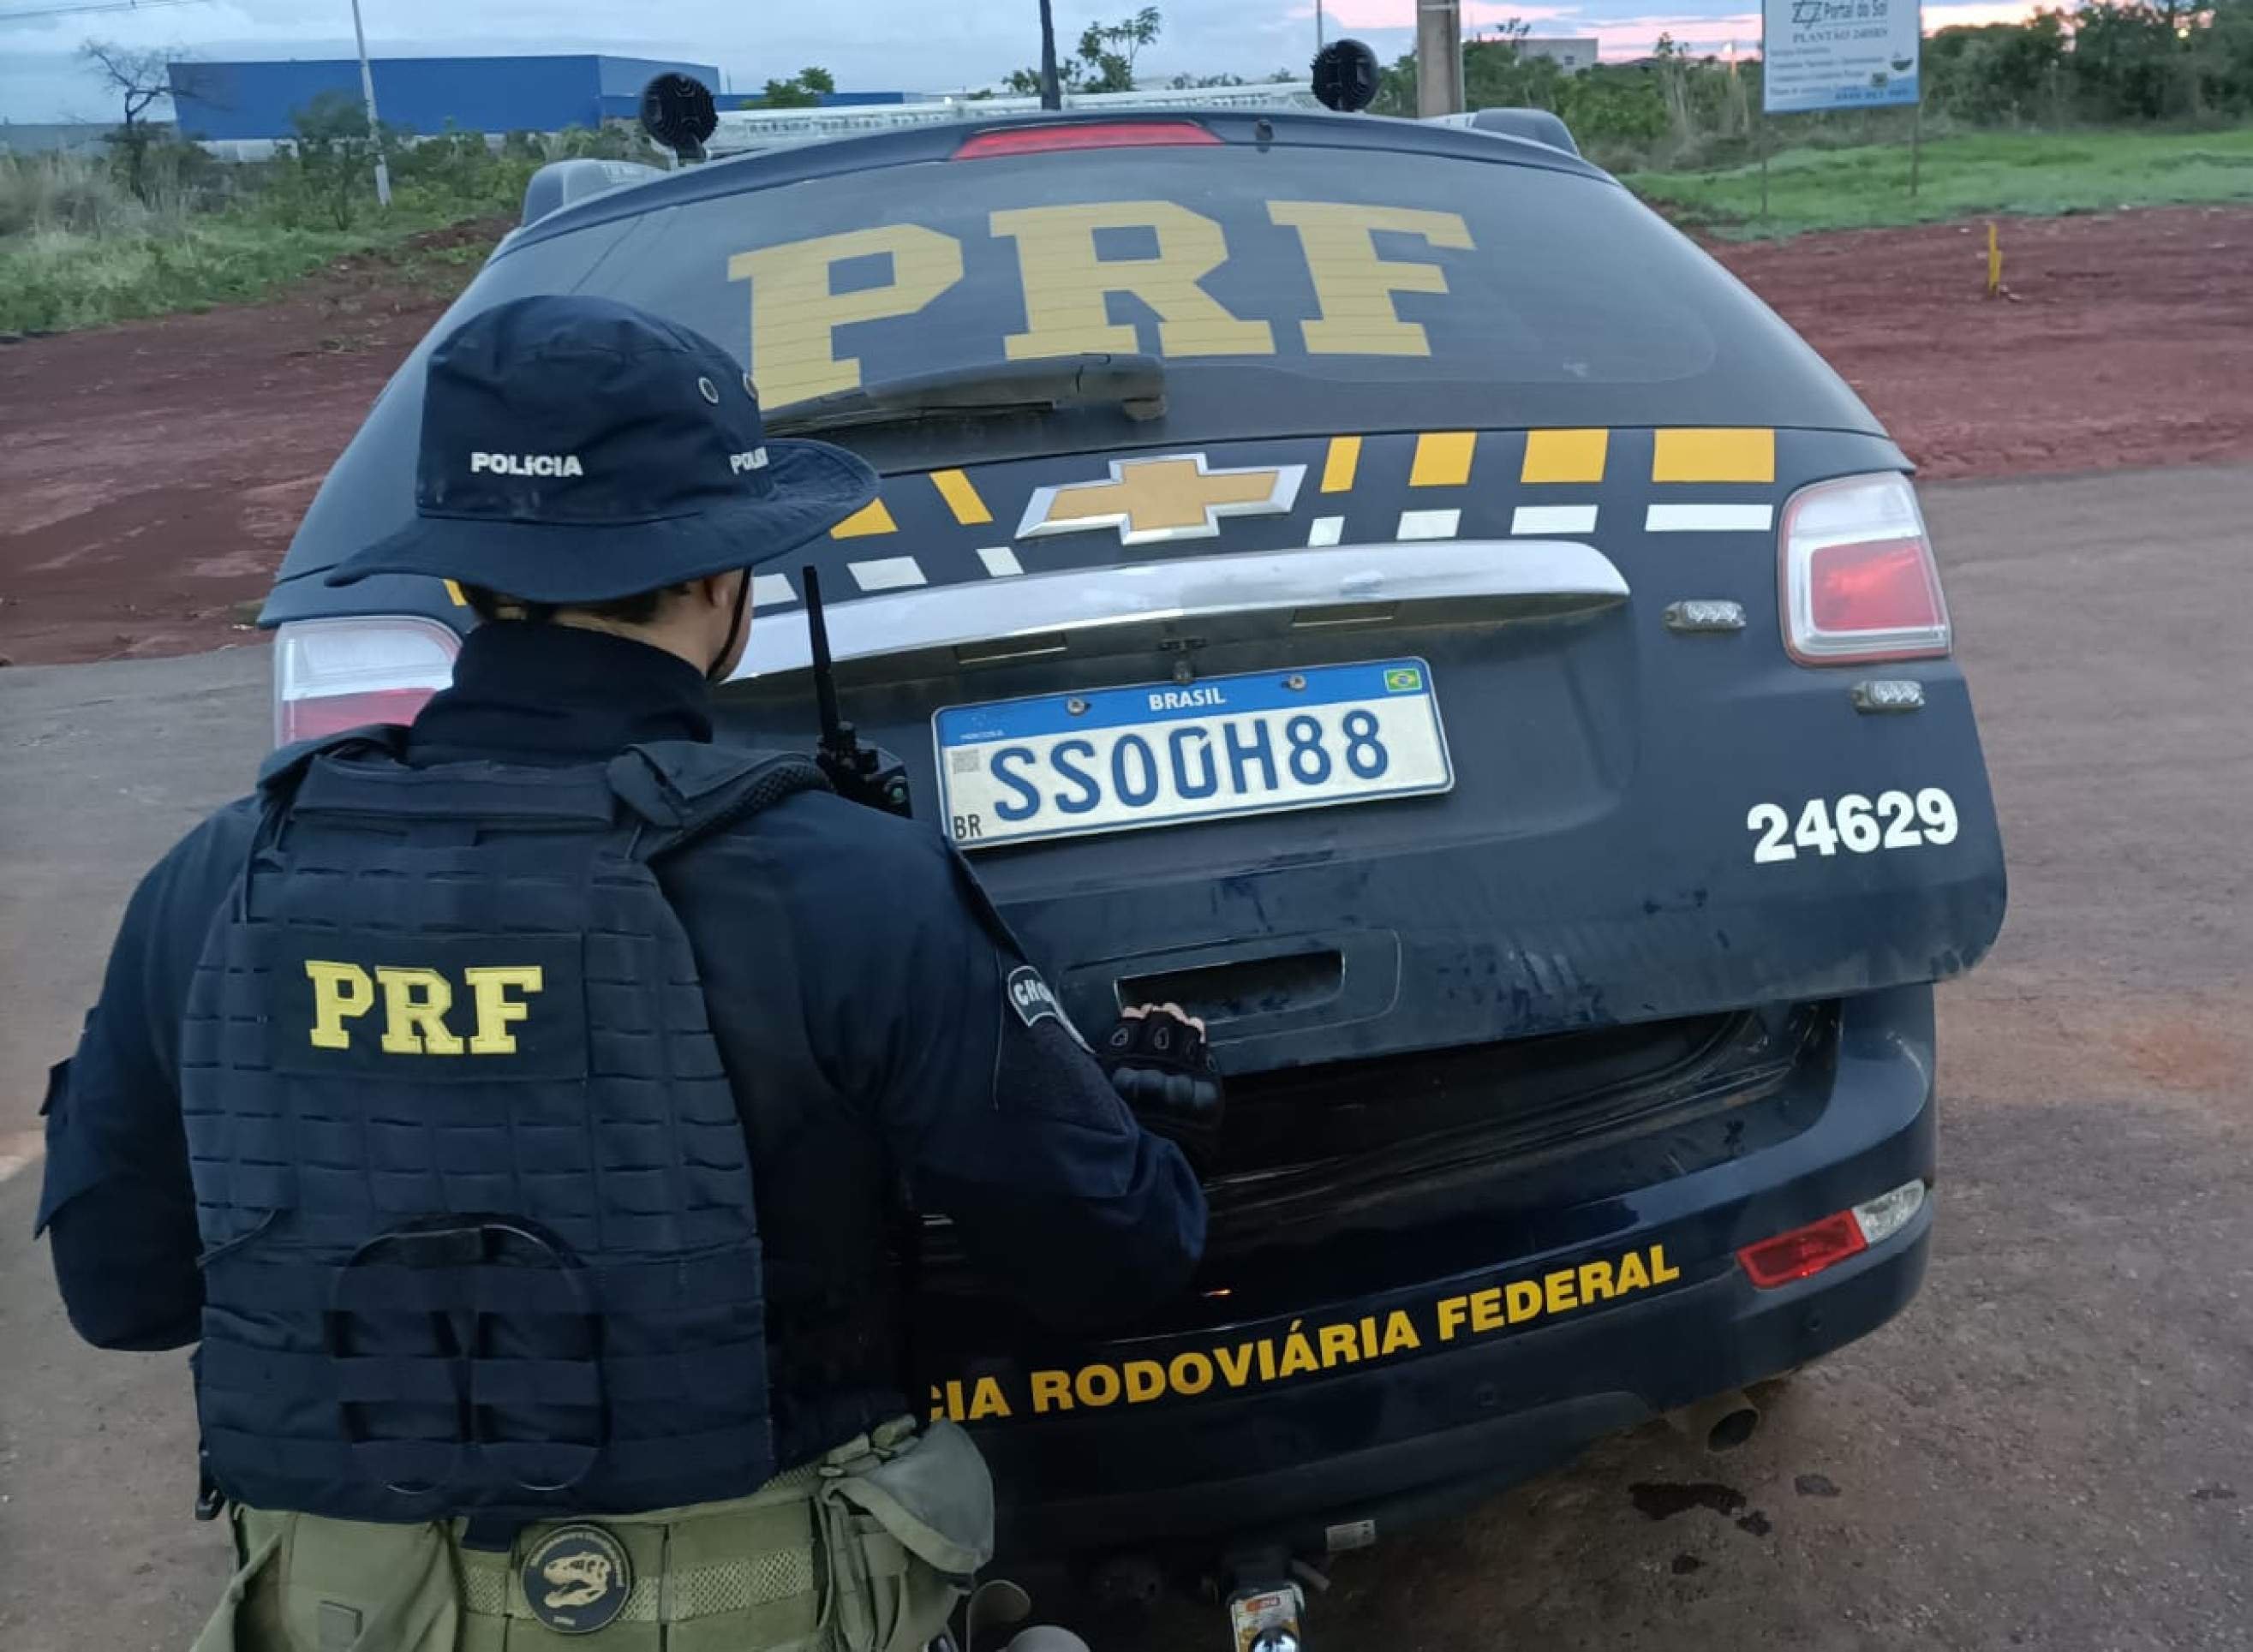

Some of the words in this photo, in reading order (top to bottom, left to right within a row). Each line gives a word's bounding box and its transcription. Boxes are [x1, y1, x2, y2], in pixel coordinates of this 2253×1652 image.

[726, 200, 1476, 411] PRF
[1149, 688, 1227, 712] BRASIL
[953, 814, 983, 840] BR
[1748, 787, 1958, 863] 24629
[305, 960, 543, 1054] PRF
[1031, 1320, 1419, 1413] RODOVIÁRIA
[1437, 1244, 1680, 1340] FEDERAL
